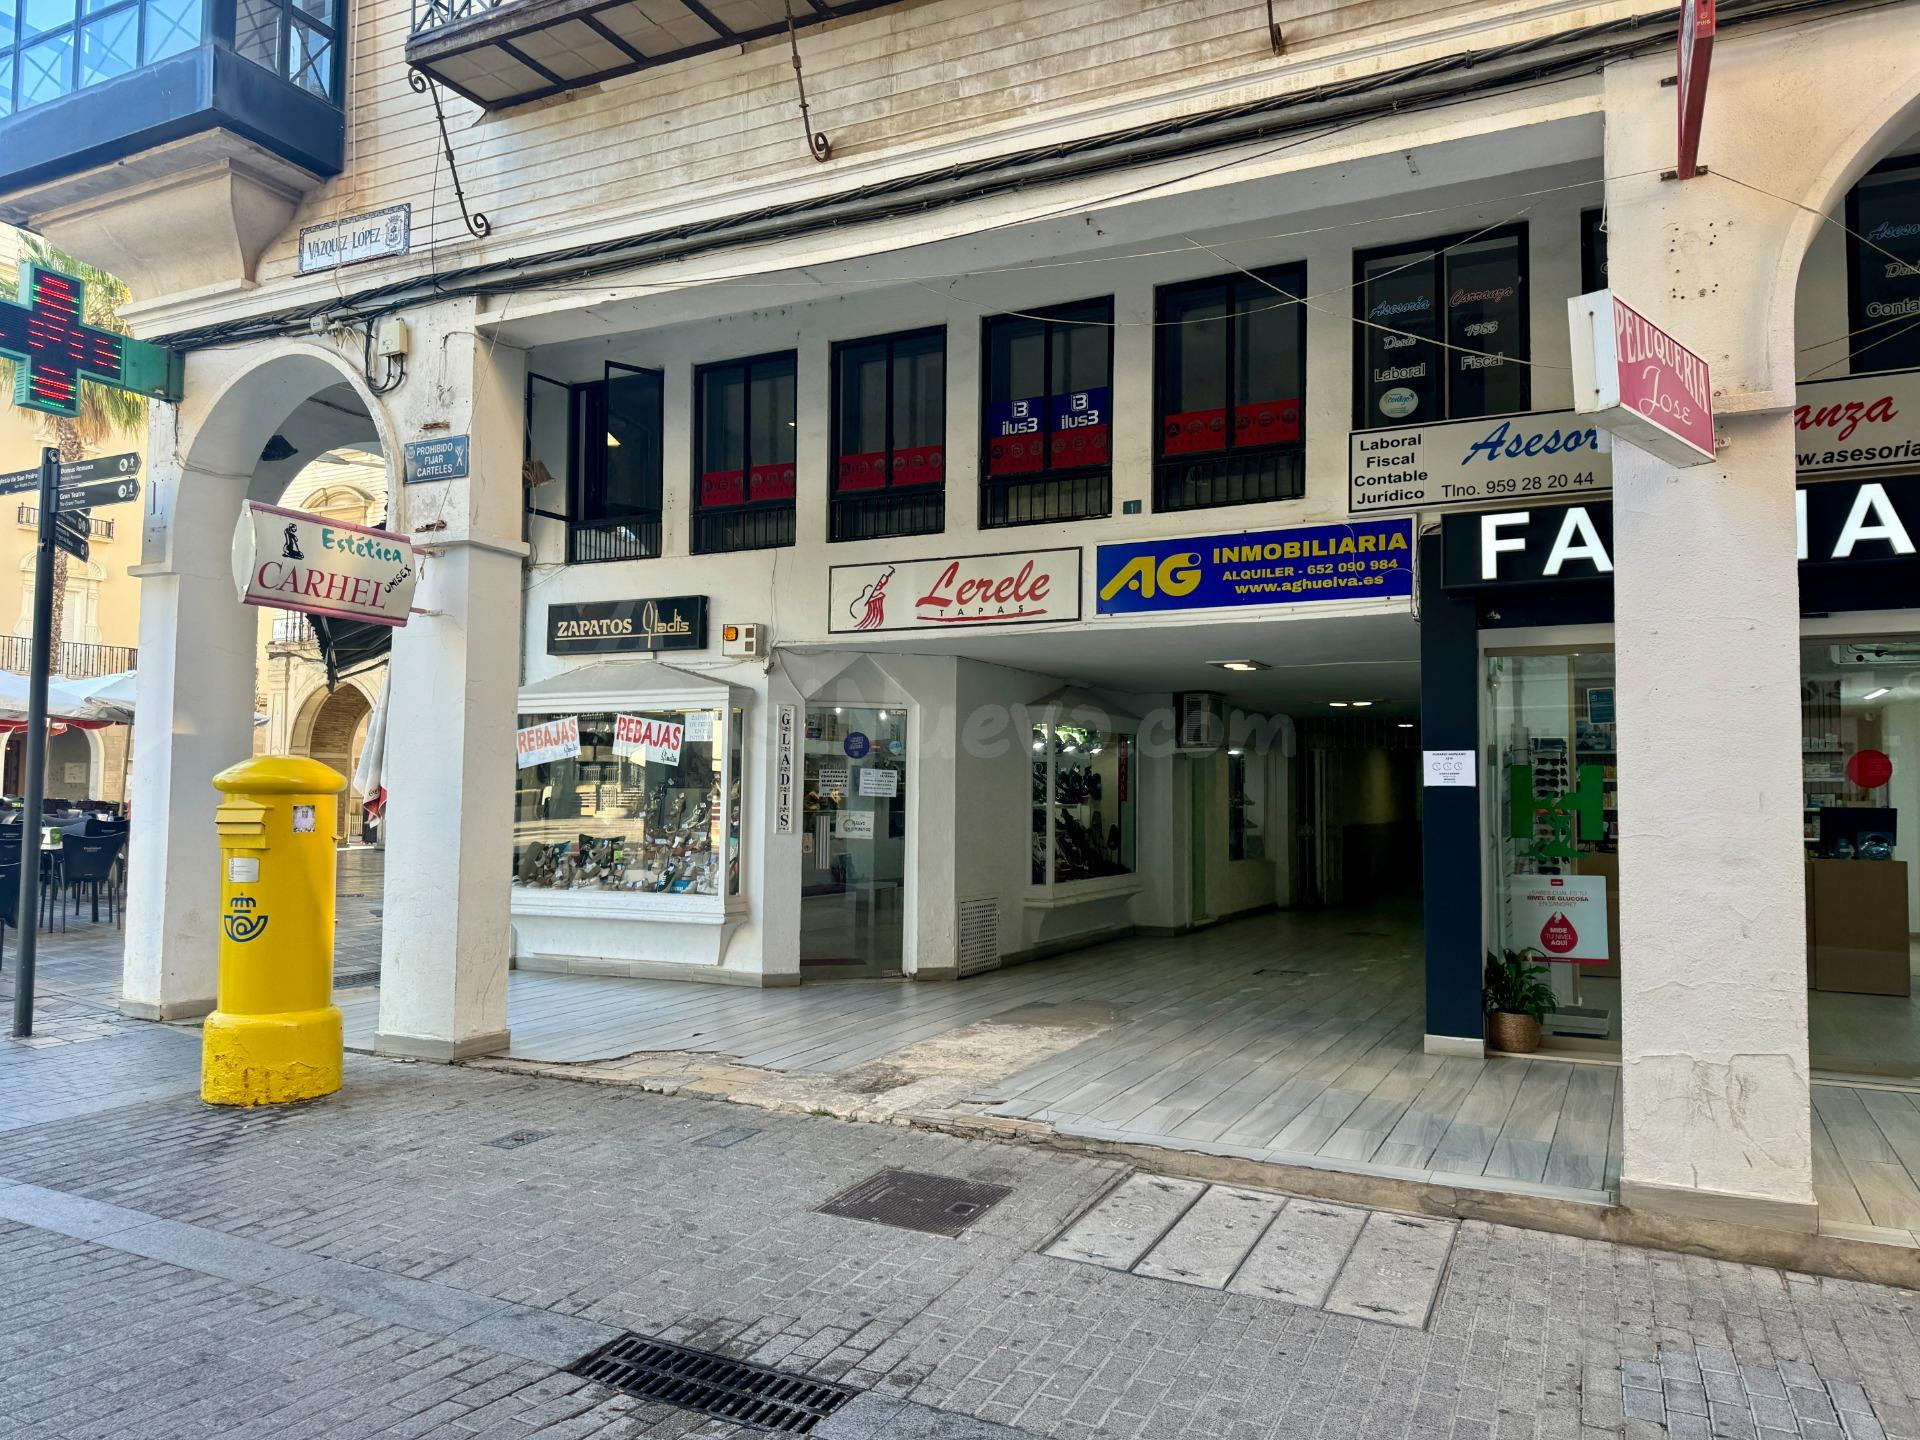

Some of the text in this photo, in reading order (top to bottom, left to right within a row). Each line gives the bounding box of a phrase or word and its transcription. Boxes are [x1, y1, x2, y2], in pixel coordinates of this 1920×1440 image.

[308, 227, 380, 260] VÁZQUEZ LÓPEZ
[1374, 352, 1503, 382] Laboral Fiscal
[1613, 303, 1709, 415] PELUQUERIA
[1002, 418, 1038, 435] ilus3
[1061, 410, 1099, 429] ilus3
[416, 442, 453, 456] PROHIBIDO
[1360, 433, 1422, 452] Laboral
[417, 464, 453, 477] CARTELES
[424, 455, 443, 465] FIJAR
[1366, 452, 1415, 468] Fiscal
[1354, 470, 1428, 487] Contable
[1441, 471, 1594, 499] Tlno. 959 28 20 44
[1357, 488, 1425, 505] Jurídico
[322, 528, 402, 563] Estética
[1213, 532, 1407, 564] INMOBILIARIA
[384, 564, 412, 593] UNISEX
[1100, 553, 1201, 600] AG
[1222, 567, 1294, 581] ALQUILER
[1307, 563, 1333, 575] 652
[1337, 561, 1365, 572] 090
[1371, 558, 1398, 570] 984
[258, 561, 386, 610] CARHEL
[915, 560, 1050, 607] Lerele
[1235, 574, 1384, 594] www.aghuelva.es
[940, 604, 1024, 617] TAPAS
[557, 618, 632, 637] ZAPATOS
[518, 719, 577, 754] REBAJAS
[616, 716, 681, 752] REBAJAS
[779, 712, 791, 827] GLADIS
